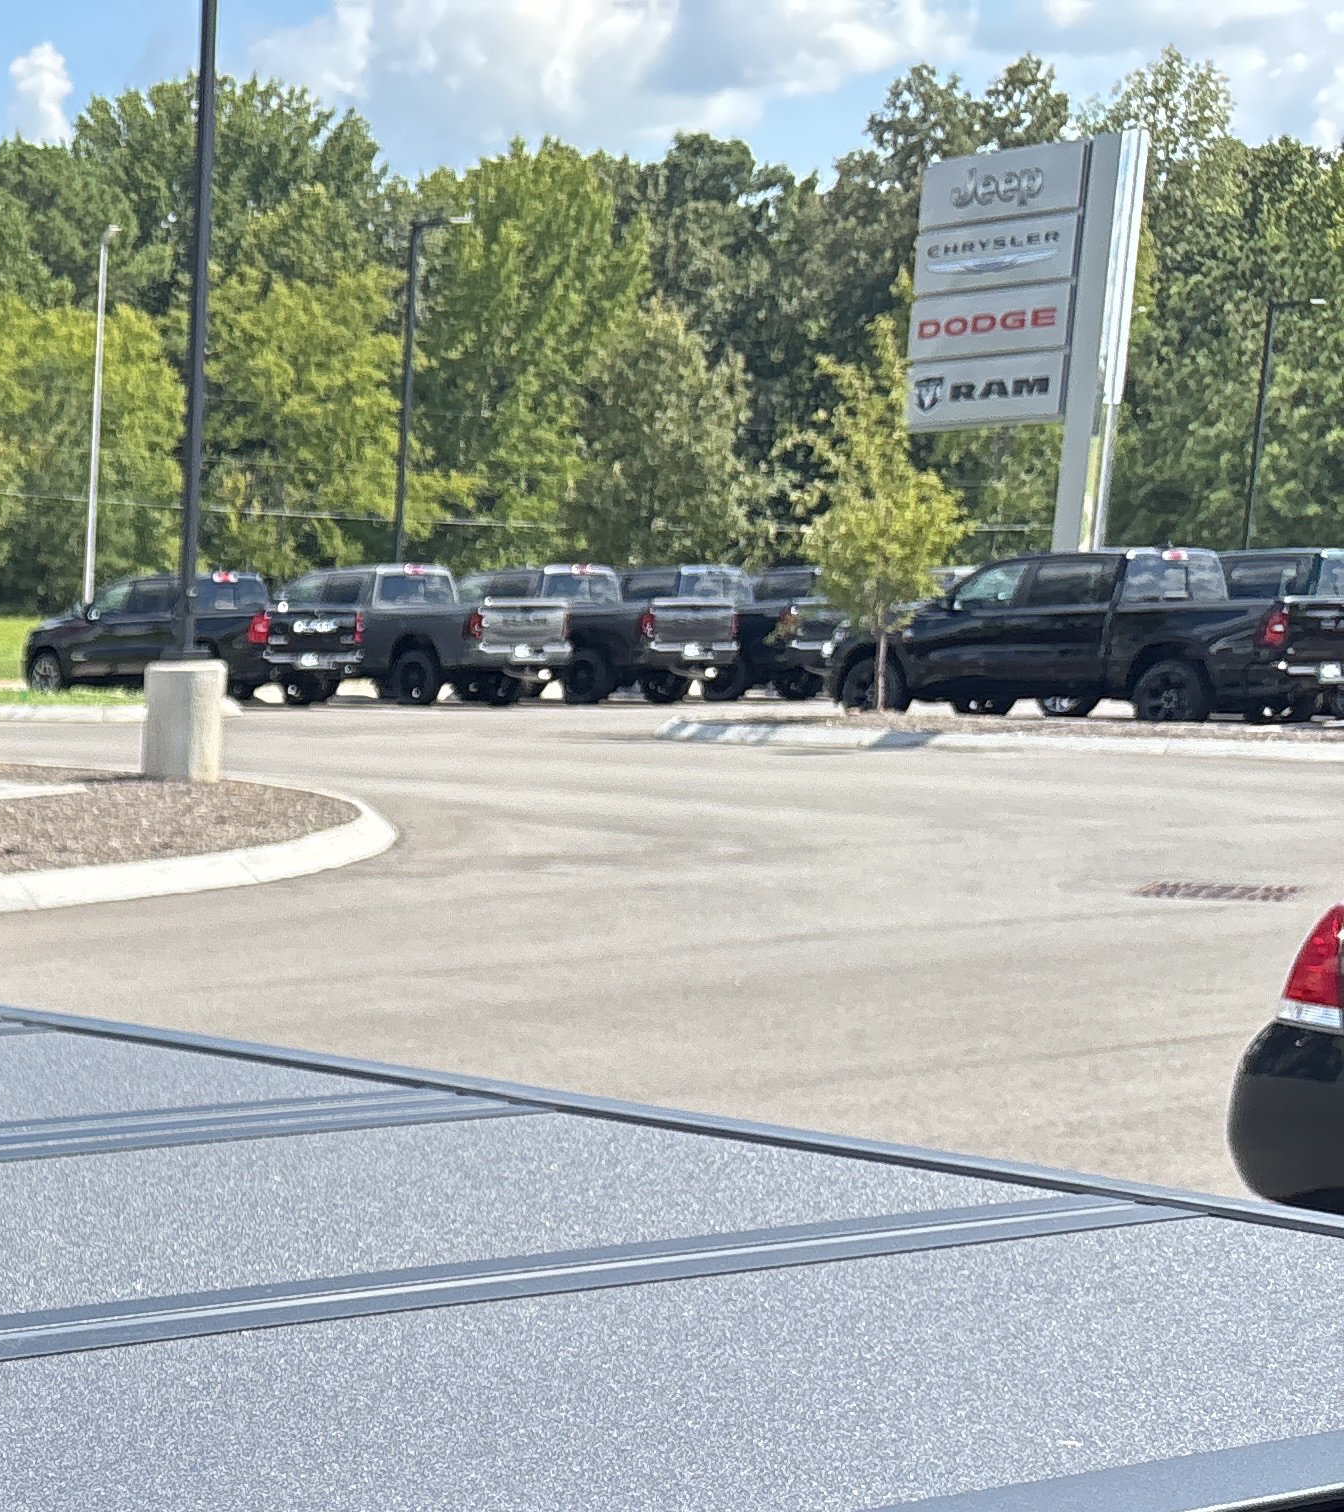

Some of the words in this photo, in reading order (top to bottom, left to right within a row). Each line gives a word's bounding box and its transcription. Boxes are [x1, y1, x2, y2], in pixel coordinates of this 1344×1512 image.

[952, 166, 1044, 208] Jeep
[927, 230, 1061, 259] CHRYSLER
[917, 306, 1057, 341] DODGE
[949, 375, 1051, 402] RAM
